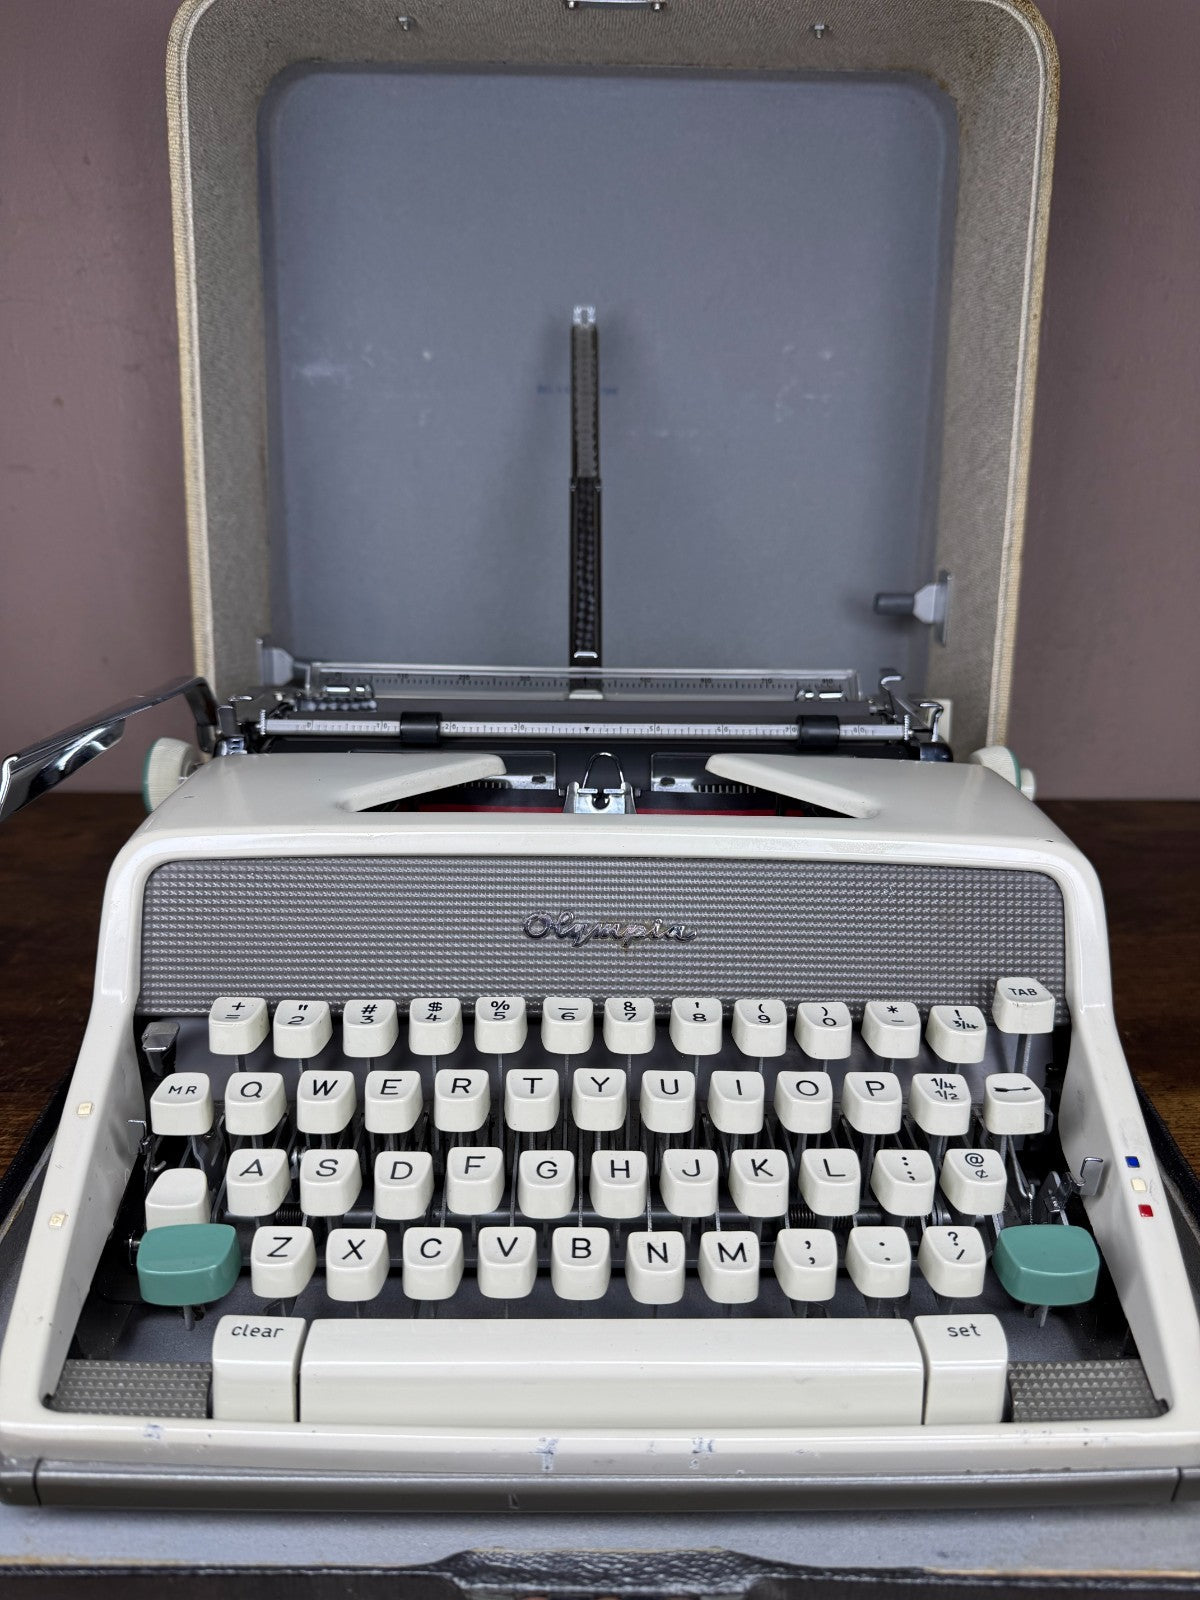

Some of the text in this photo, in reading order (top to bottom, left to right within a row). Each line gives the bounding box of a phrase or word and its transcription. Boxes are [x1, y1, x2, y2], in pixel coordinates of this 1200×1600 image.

[444, 722, 458, 730] 20
[512, 723, 526, 731] 30
[648, 725, 662, 733] 50
[522, 909, 698, 948] Olympia
[1008, 987, 1038, 996] TAB
[231, 1001, 246, 1011] +
[361, 1004, 378, 1015] #
[427, 1001, 443, 1012] $
[490, 1000, 511, 1011] %
[623, 1001, 637, 1012] &
[758, 1003, 765, 1014] (
[821, 1006, 829, 1017] )
[287, 1015, 305, 1025] 2
[359, 1015, 374, 1025] 3
[425, 1012, 441, 1022] 4
[492, 1011, 506, 1021] 5
[560, 1012, 576, 1021] 6
[624, 1012, 637, 1021] 7
[692, 1013, 707, 1022] 8
[757, 1014, 771, 1024] 9
[954, 1009, 963, 1020] !
[240, 1081, 263, 1099] Q
[313, 1079, 338, 1097] W
[380, 1078, 403, 1096] E
[451, 1077, 472, 1094] R
[522, 1077, 543, 1094] T
[590, 1076, 610, 1093] Y
[660, 1078, 679, 1095] U
[735, 1079, 743, 1096] I
[795, 1079, 820, 1097] O
[865, 1080, 885, 1097] P
[239, 1158, 264, 1177] A
[315, 1158, 339, 1177] S
[464, 1155, 486, 1175] F
[681, 1158, 701, 1177] J
[750, 1158, 772, 1177] K
[822, 1158, 846, 1177] L
[901, 1156, 909, 1166] :
[964, 1152, 985, 1168] @
[390, 1161, 414, 1180] D
[536, 1160, 558, 1180] G
[610, 1159, 631, 1179] H
[266, 1236, 293, 1258] Z
[496, 1236, 519, 1258] V
[947, 1231, 959, 1247] ?
[341, 1239, 366, 1260] X
[420, 1237, 442, 1259] C
[571, 1237, 592, 1259] B
[646, 1242, 669, 1264] N
[717, 1242, 747, 1263] M
[230, 1321, 285, 1339] clear
[945, 1321, 983, 1339] set
